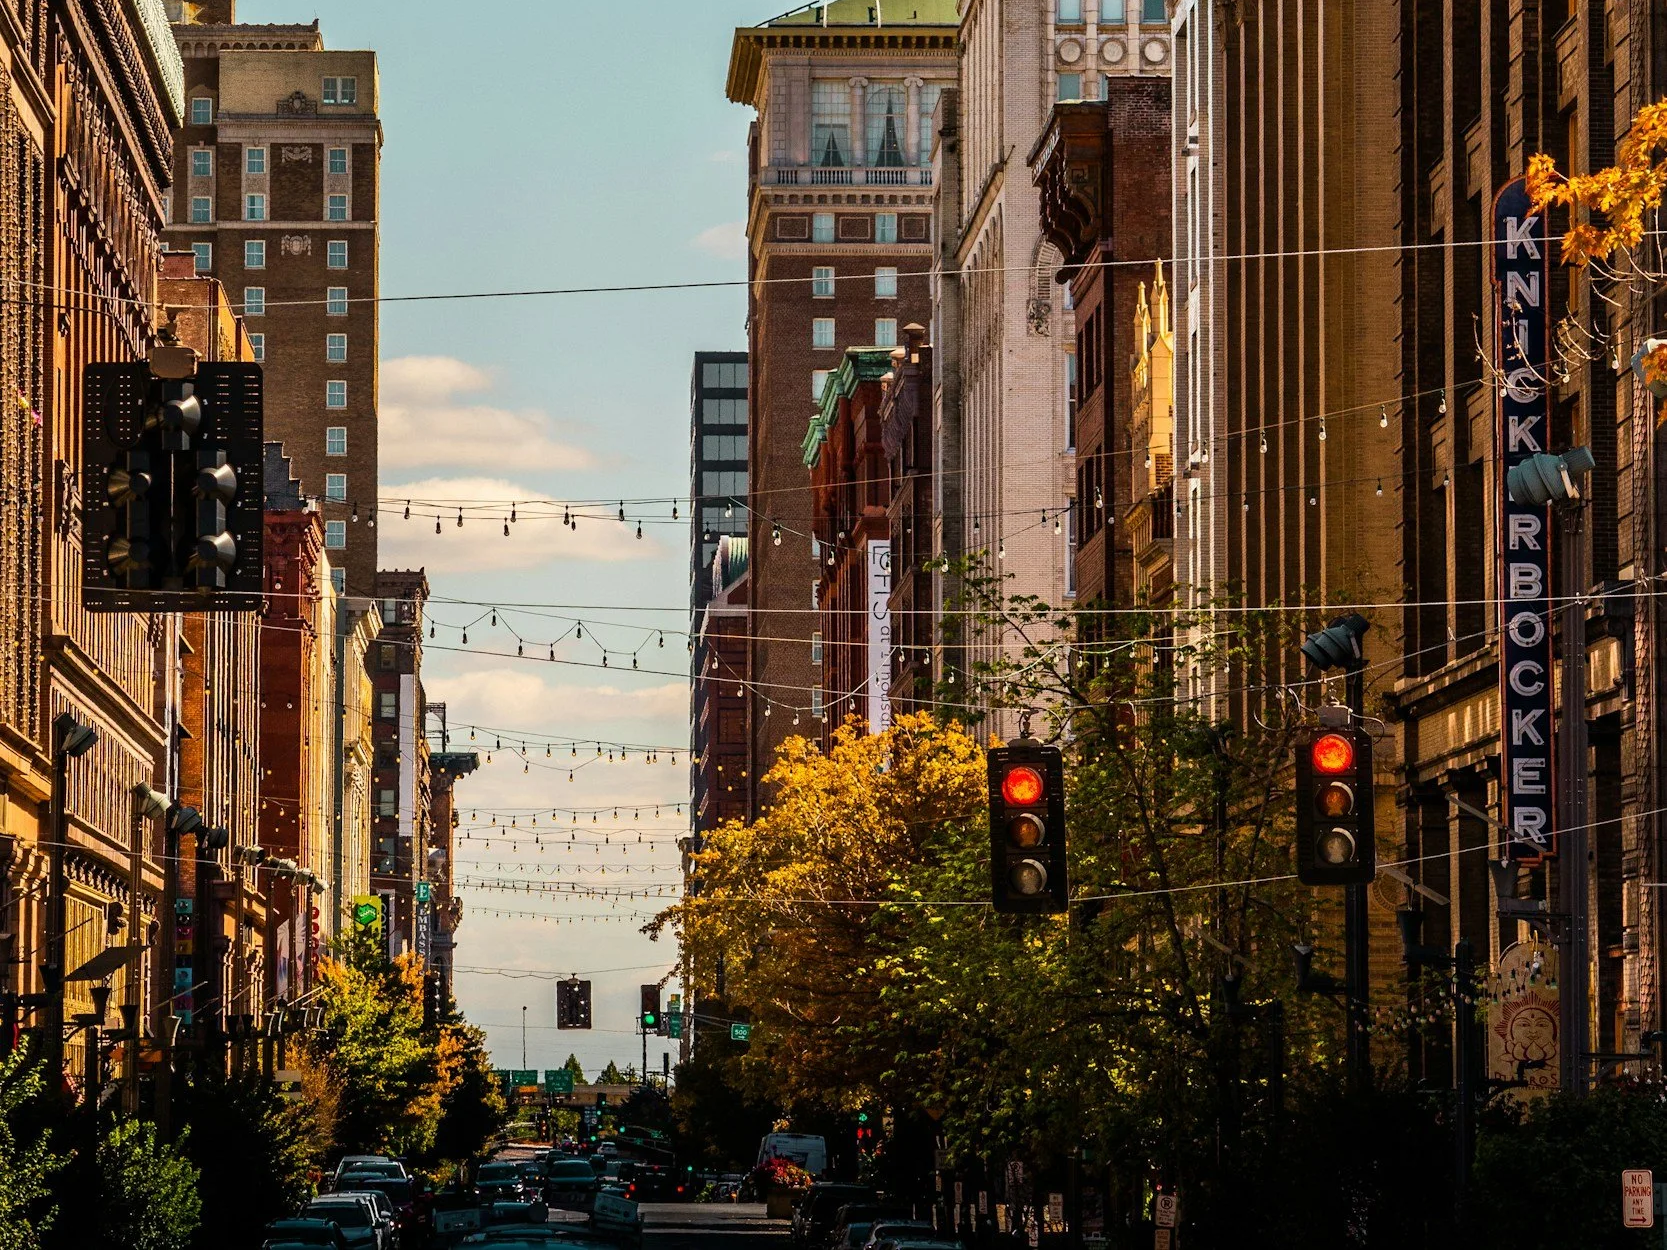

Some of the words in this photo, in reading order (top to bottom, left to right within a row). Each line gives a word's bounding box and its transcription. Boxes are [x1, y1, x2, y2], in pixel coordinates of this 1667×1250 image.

[1506, 216, 1547, 843] KNICKRBOCKER
[417, 908, 428, 956] EMBASS
[1631, 1174, 1643, 1184] NO
[1624, 1186, 1651, 1197] PARKING
[1632, 1198, 1643, 1206] ANY
[1632, 1207, 1644, 1215] TIME
